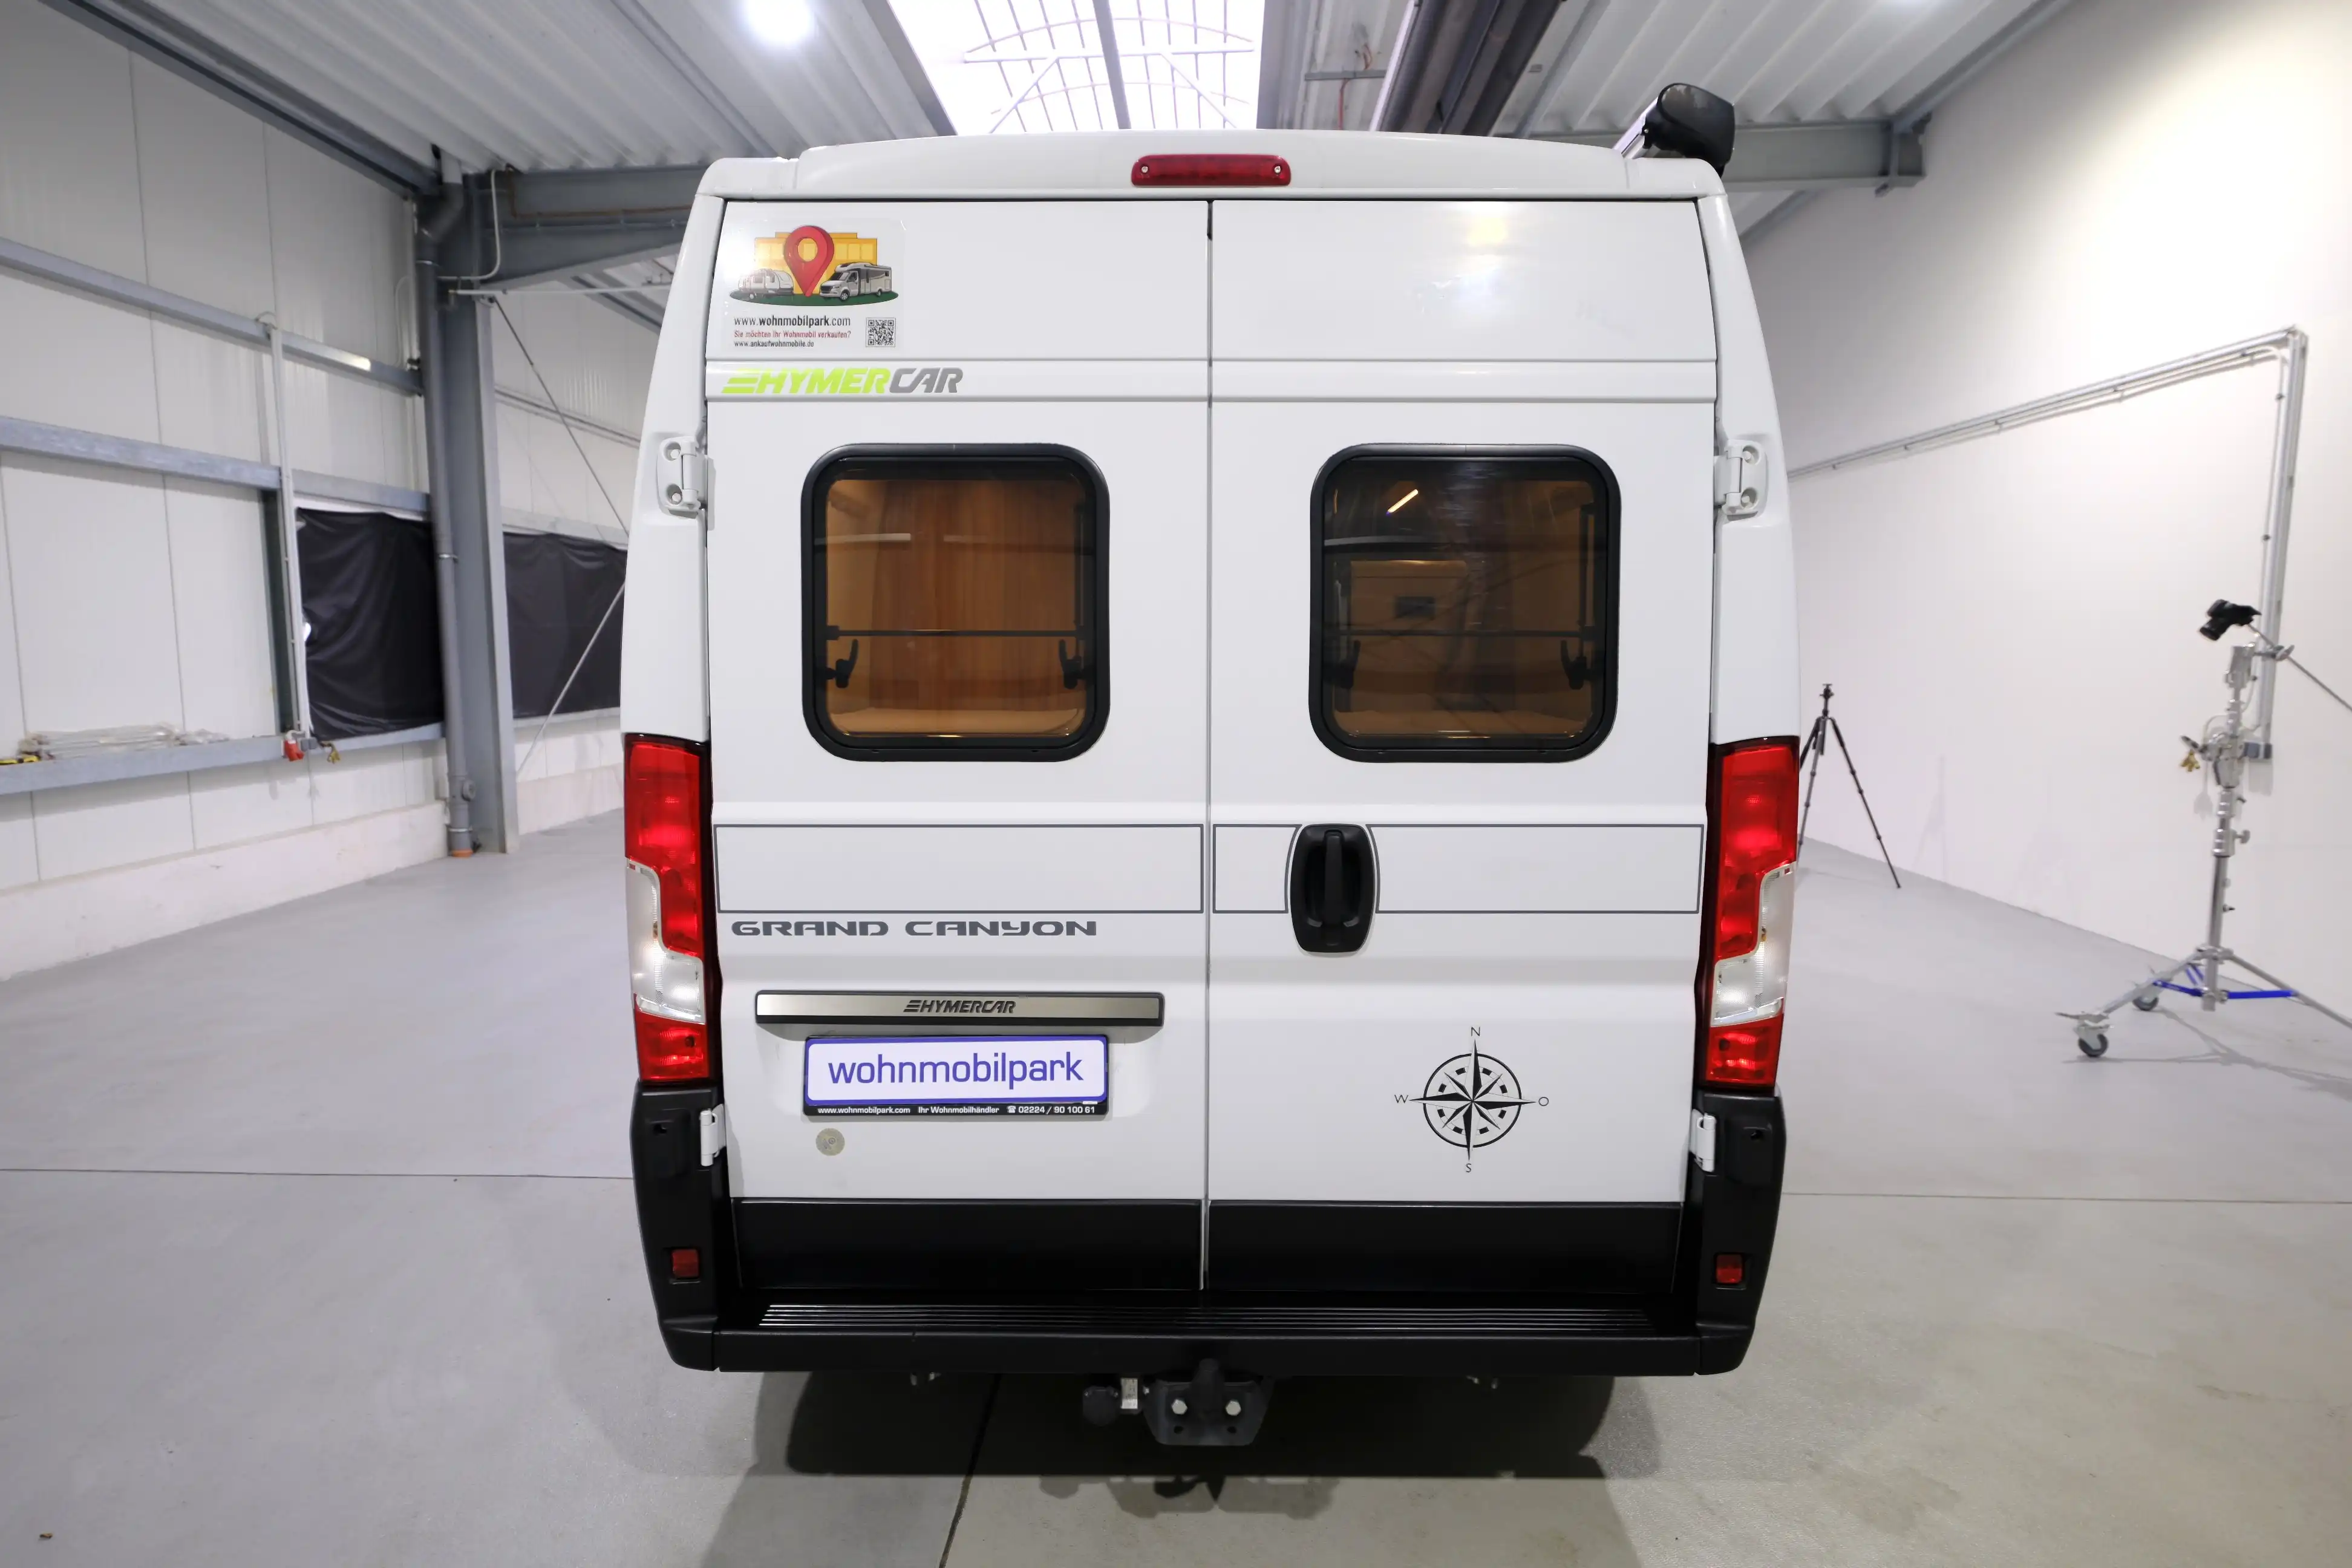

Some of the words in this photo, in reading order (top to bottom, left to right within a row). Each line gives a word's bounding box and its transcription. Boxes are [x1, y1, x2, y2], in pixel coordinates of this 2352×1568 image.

[734, 315, 851, 328] www.wohnmobilpark.com
[754, 367, 964, 394] HYMERCAR
[731, 921, 889, 936] GRAND
[905, 921, 1097, 936] CANYON
[919, 999, 1016, 1014] HYMERCAR
[1471, 1026, 1481, 1037] N
[828, 1051, 1084, 1089] wohnmobilpark
[1394, 1094, 1409, 1104] W
[1538, 1096, 1549, 1106] O
[817, 1106, 910, 1115] www.wohnmobilpark.com
[1465, 1163, 1472, 1173] S
